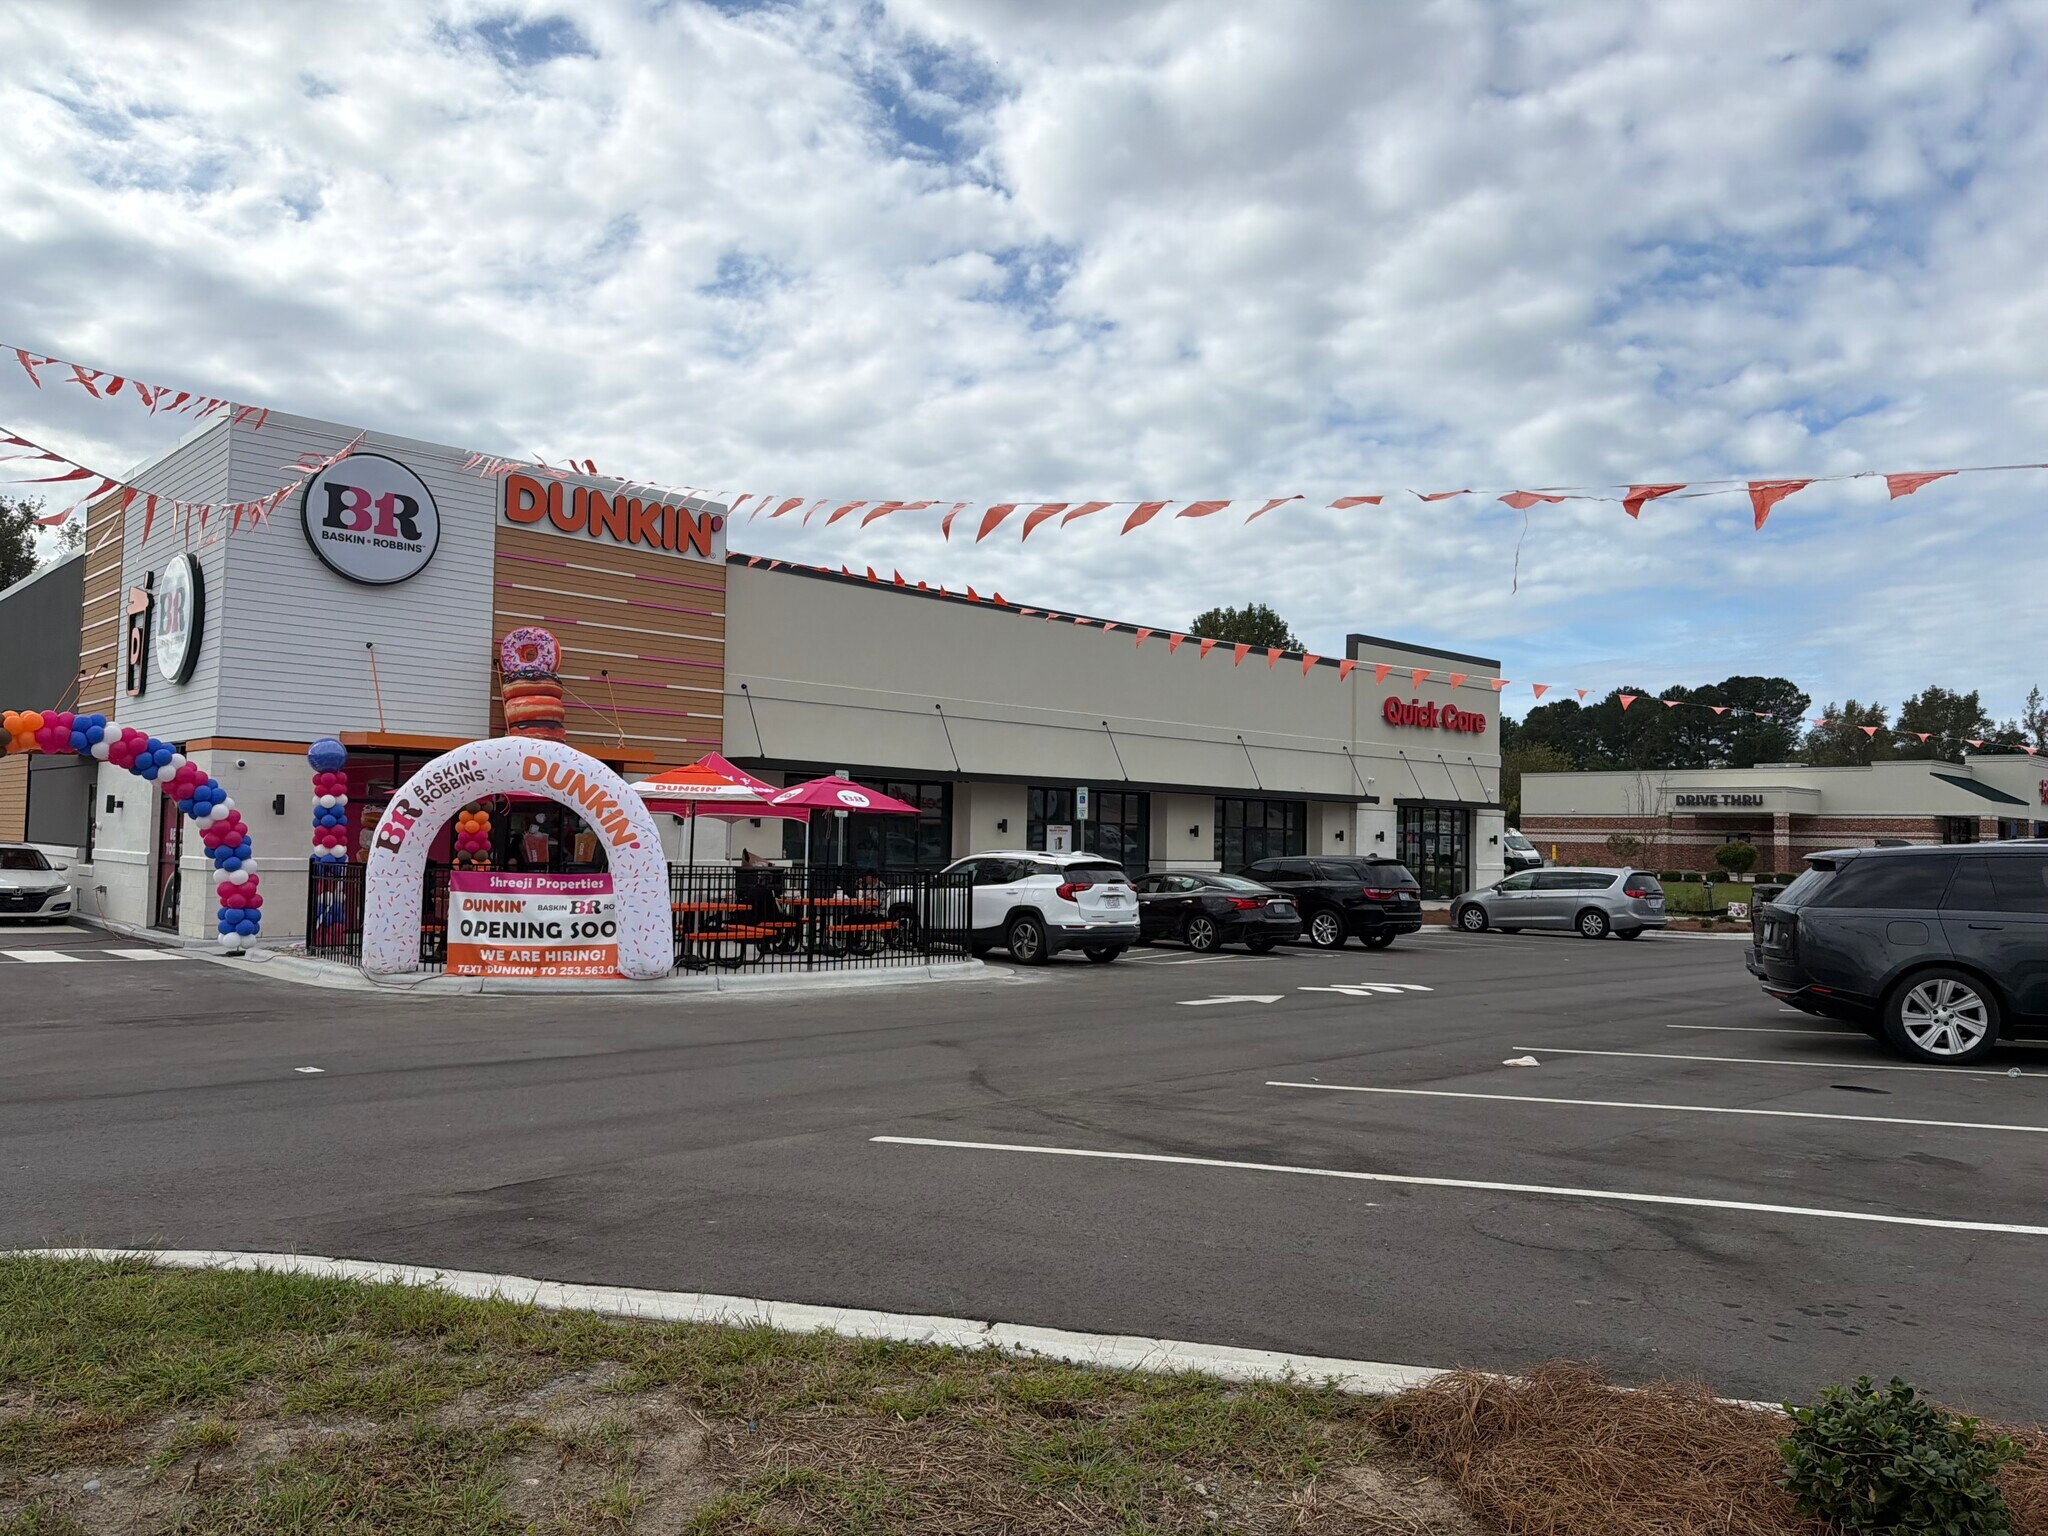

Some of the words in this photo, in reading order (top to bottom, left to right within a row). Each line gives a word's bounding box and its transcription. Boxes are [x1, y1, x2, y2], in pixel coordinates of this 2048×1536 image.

[322, 482, 423, 541] BR
[505, 473, 724, 558] DUNKIN'
[322, 530, 366, 545] BASKIN
[373, 538, 423, 553] ROBBINS
[1383, 696, 1440, 729] Quick
[1441, 703, 1486, 734] Care
[413, 760, 471, 798] BASKIN
[420, 769, 486, 807] ROBBINS
[655, 784, 722, 793] DUNKIN'
[522, 756, 641, 850] DUNKIN'
[1675, 794, 1718, 807] DRIVE
[1721, 794, 1764, 807] THRU
[376, 798, 423, 854] BR
[489, 876, 532, 890] Shreeji
[536, 877, 604, 891] Properties
[462, 898, 527, 914] DUNKIN'
[569, 900, 602, 915] BR
[460, 919, 562, 939] OPENING
[480, 949, 505, 962] WE
[509, 950, 540, 962] ARE
[545, 949, 606, 962] HIRING!
[457, 964, 482, 974] TEXT
[541, 966, 556, 976] TO
